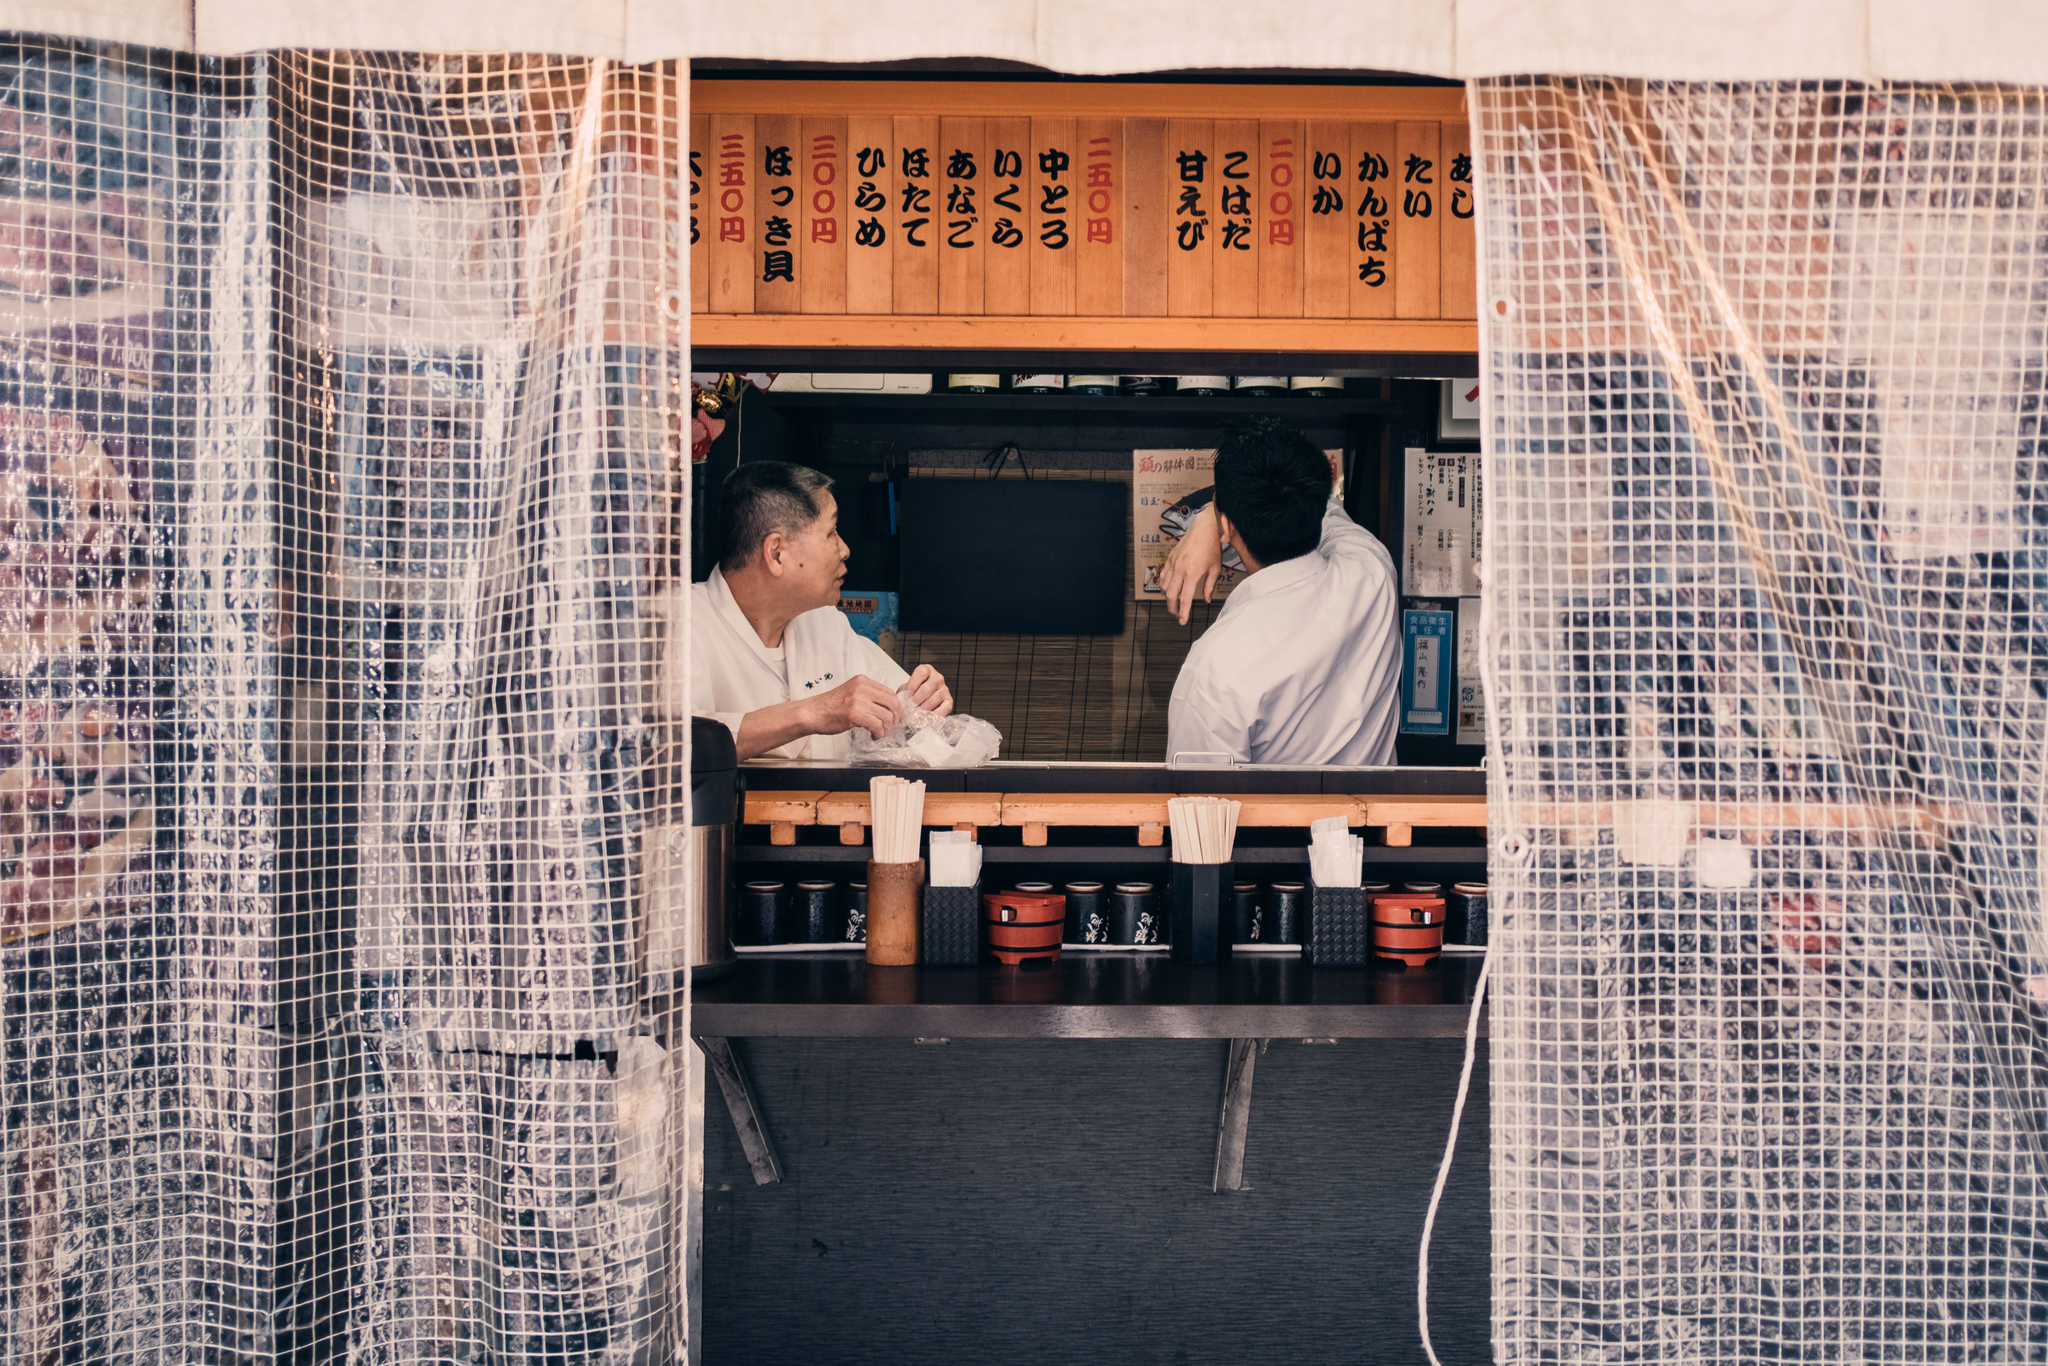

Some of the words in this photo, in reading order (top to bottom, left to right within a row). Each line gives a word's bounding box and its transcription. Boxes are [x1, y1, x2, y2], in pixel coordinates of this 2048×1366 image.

[720, 134, 745, 242] 三五〇円
[762, 145, 795, 283] ほっき貝
[812, 134, 837, 243] 三〇〇円
[854, 147, 886, 248] ひらめ
[902, 147, 930, 247] ほたて
[946, 148, 979, 249] あなご
[991, 149, 1023, 248] いくら
[1039, 148, 1070, 250] 中とろ
[1087, 137, 1113, 244] 二五〇円
[1175, 150, 1209, 251] 甘えび
[1221, 151, 1252, 250] こはだ
[1269, 138, 1299, 245] 二〇〇円
[1312, 151, 1344, 215] いか
[1357, 151, 1390, 287] かんぱち
[1403, 153, 1433, 218] たい
[1409, 625, 1447, 635] 責任者
[1410, 615, 1447, 625] 食品衛生
